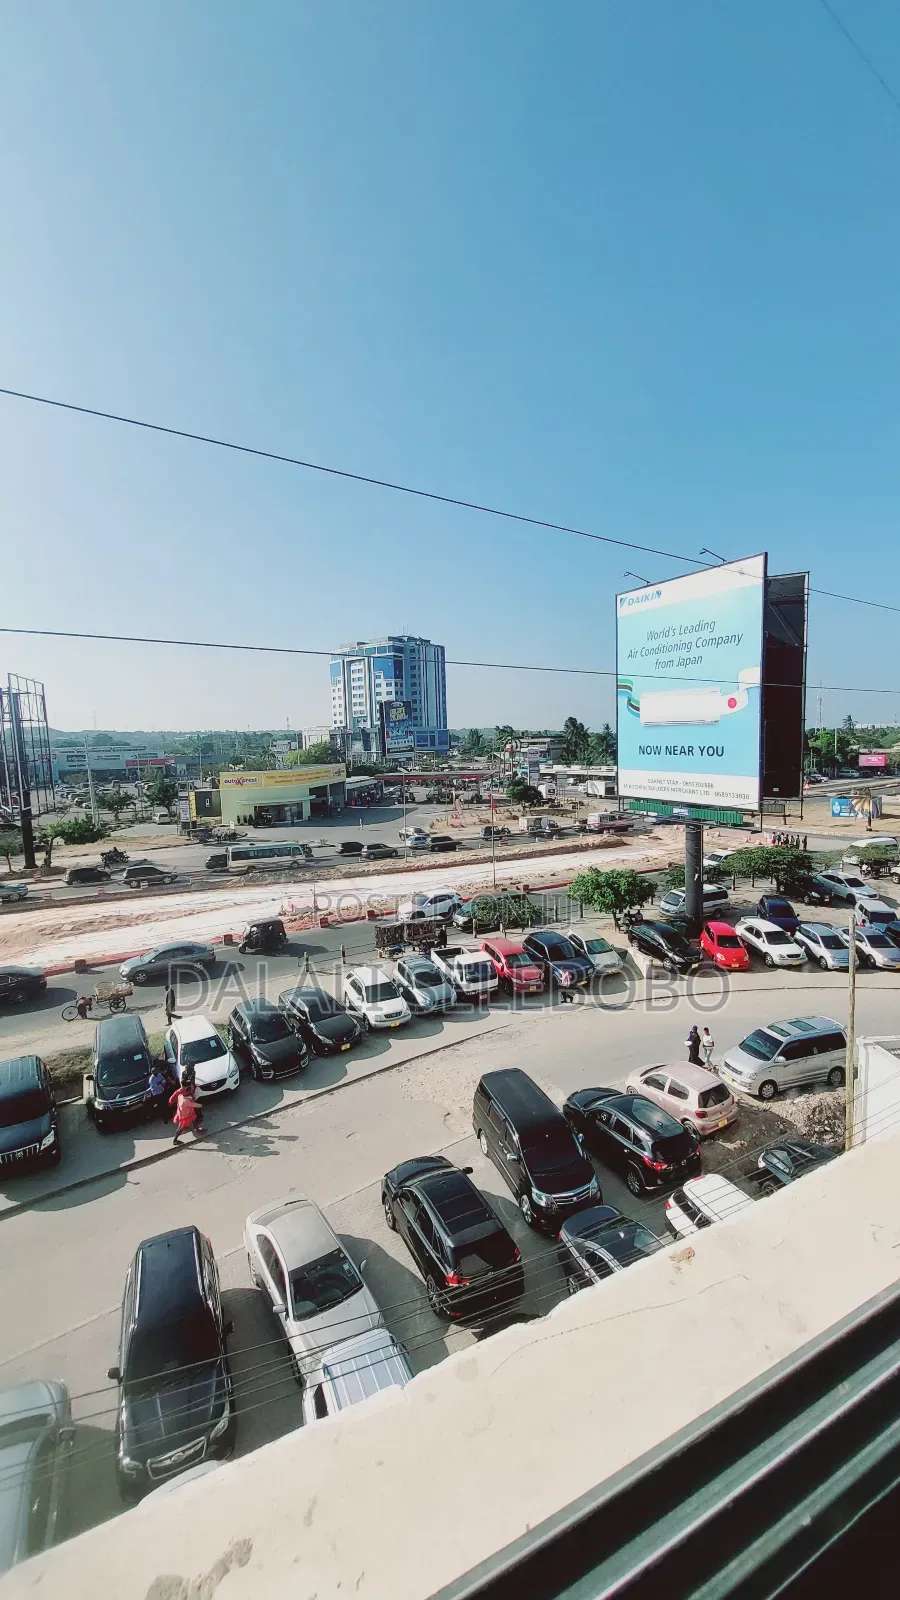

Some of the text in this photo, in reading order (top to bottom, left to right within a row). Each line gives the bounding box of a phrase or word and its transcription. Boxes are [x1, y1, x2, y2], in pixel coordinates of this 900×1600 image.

[627, 590, 662, 606] DAIKIN
[646, 620, 716, 641] World's Leading
[628, 633, 744, 659] Air Conditioning Company
[654, 655, 703, 670] from Japan
[638, 745, 725, 758] NOW NEAR YOU
